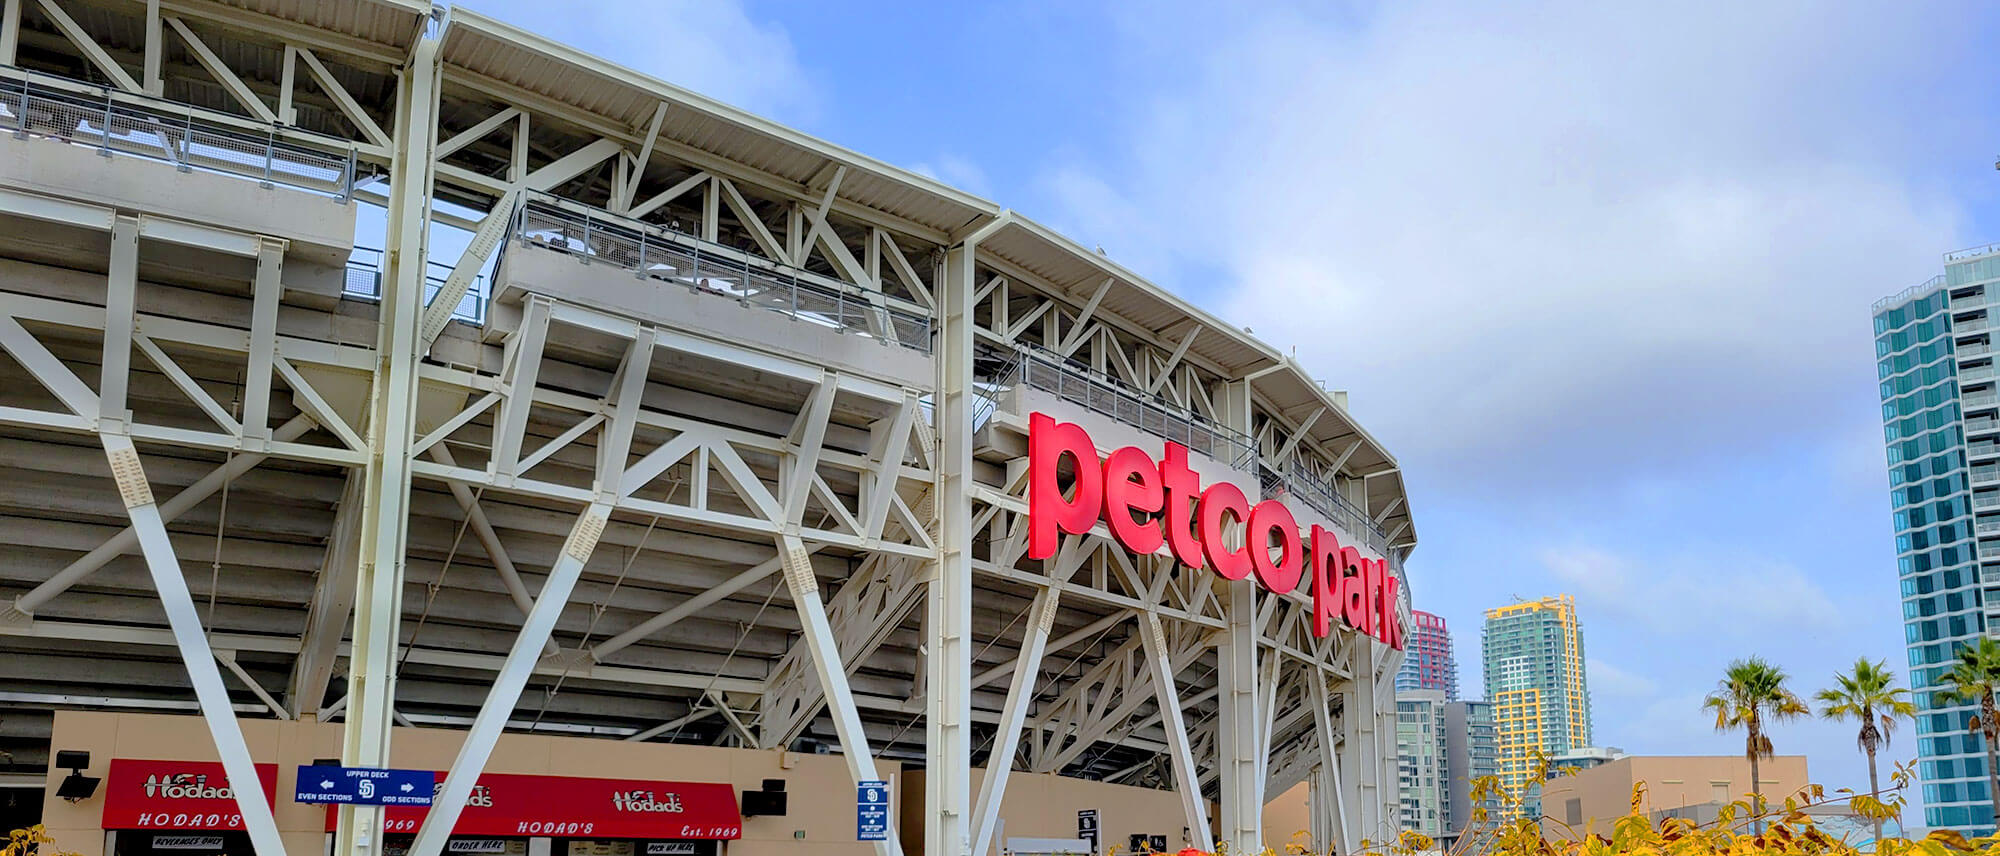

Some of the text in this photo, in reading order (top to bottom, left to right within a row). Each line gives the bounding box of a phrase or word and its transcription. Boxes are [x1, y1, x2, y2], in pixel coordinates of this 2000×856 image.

[1028, 411, 1403, 651] petco park
[346, 770, 389, 779] UPPER DECK
[318, 793, 353, 801] SECTIONS
[397, 796, 431, 804] SECTIONS
[137, 813, 241, 827] HODAD'S
[517, 821, 594, 834] HODAD'S
[680, 825, 738, 838] Est. 1969
[155, 836, 223, 846] BEVERAGES ONLY
[451, 840, 481, 849] ORDER
[482, 839, 504, 848] HERE
